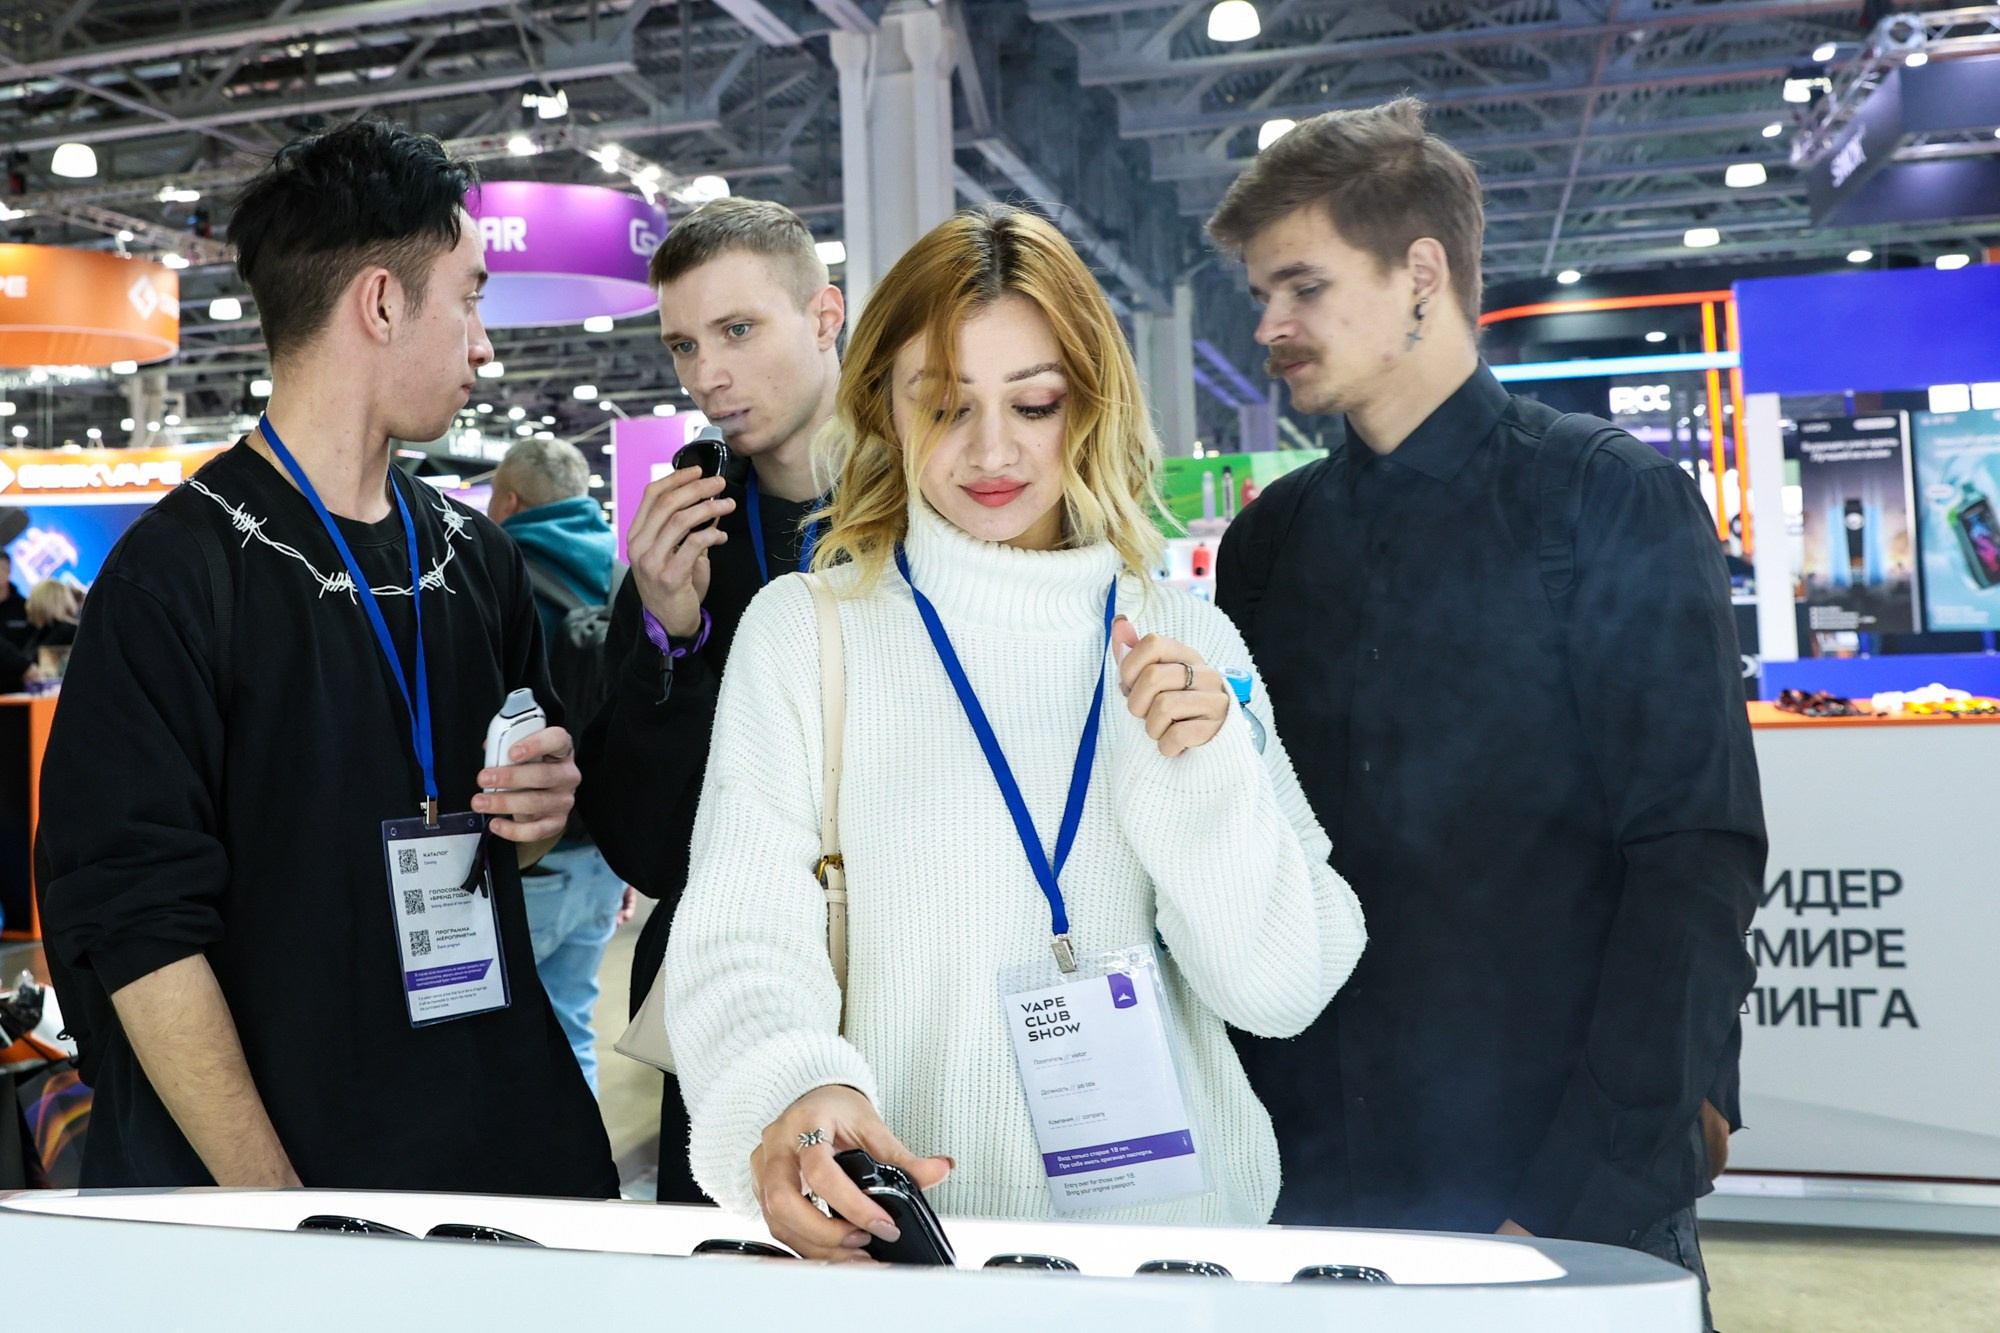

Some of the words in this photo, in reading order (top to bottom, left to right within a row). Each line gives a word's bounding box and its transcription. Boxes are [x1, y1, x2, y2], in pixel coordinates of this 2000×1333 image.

[478, 216, 528, 252] AR
[428, 887, 461, 895] ГОЛОСОВА
[1759, 868, 1904, 916] ИДЕР
[435, 926, 470, 935] ПРОГРАММА
[436, 932, 477, 941] МЕРОПРИЯТИЯ
[1753, 928, 1907, 968] МИРЕ
[1021, 996, 1066, 1013] VAPE
[1025, 1010, 1071, 1028] CLUB
[1028, 1022, 1081, 1042] SHOW
